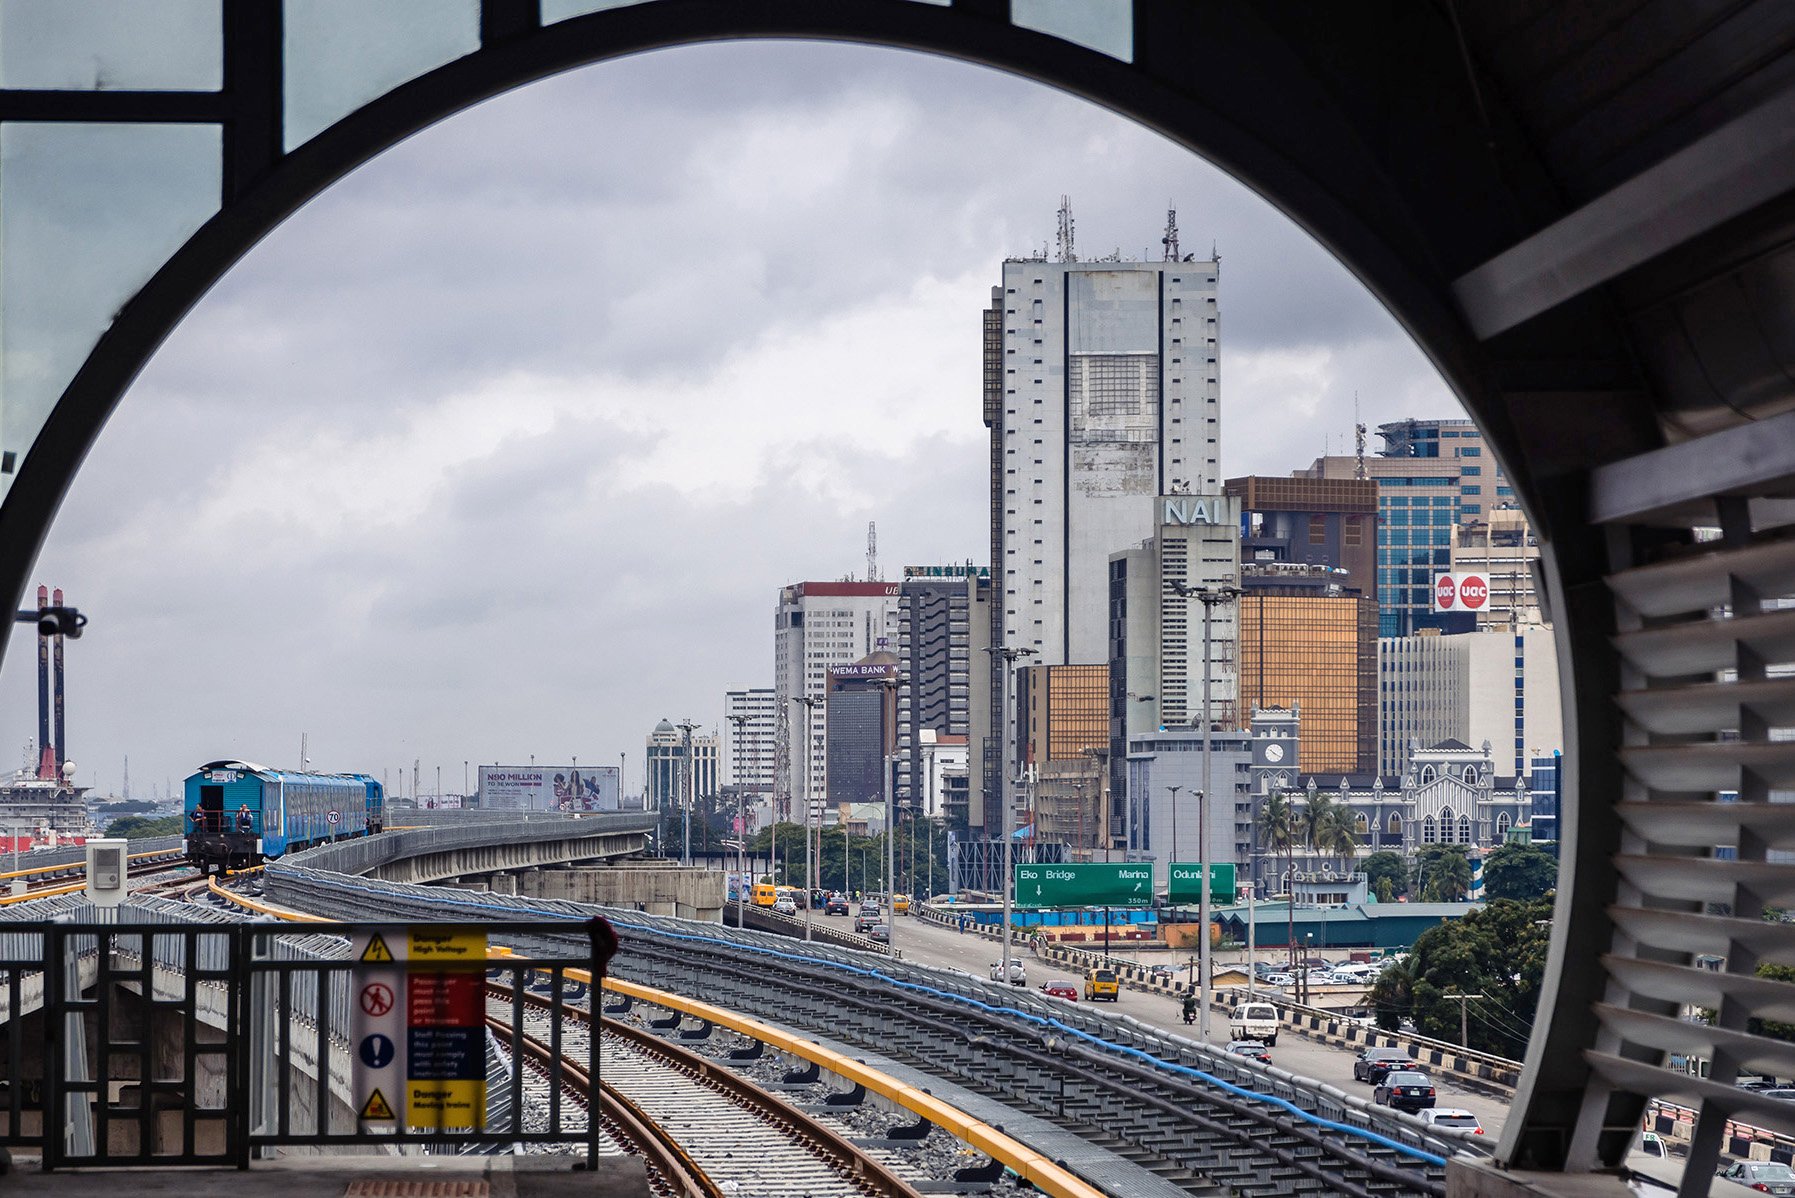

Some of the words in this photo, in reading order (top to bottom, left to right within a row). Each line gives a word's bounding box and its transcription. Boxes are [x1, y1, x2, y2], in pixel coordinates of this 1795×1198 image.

[1165, 499, 1220, 524] NAI
[832, 667, 858, 675] WEMA
[861, 666, 886, 674] BANK
[329, 813, 339, 821] 70
[1020, 870, 1038, 879] Eko
[1045, 870, 1076, 881] Bridge
[1118, 869, 1149, 879] Marina
[1173, 869, 1216, 879] Odunli
[413, 933, 452, 945] Danger
[413, 946, 433, 954] High
[435, 946, 467, 954] Voltage
[413, 978, 457, 986] Passger
[413, 1089, 453, 1101] Danger
[413, 1102, 445, 1111] Moving
